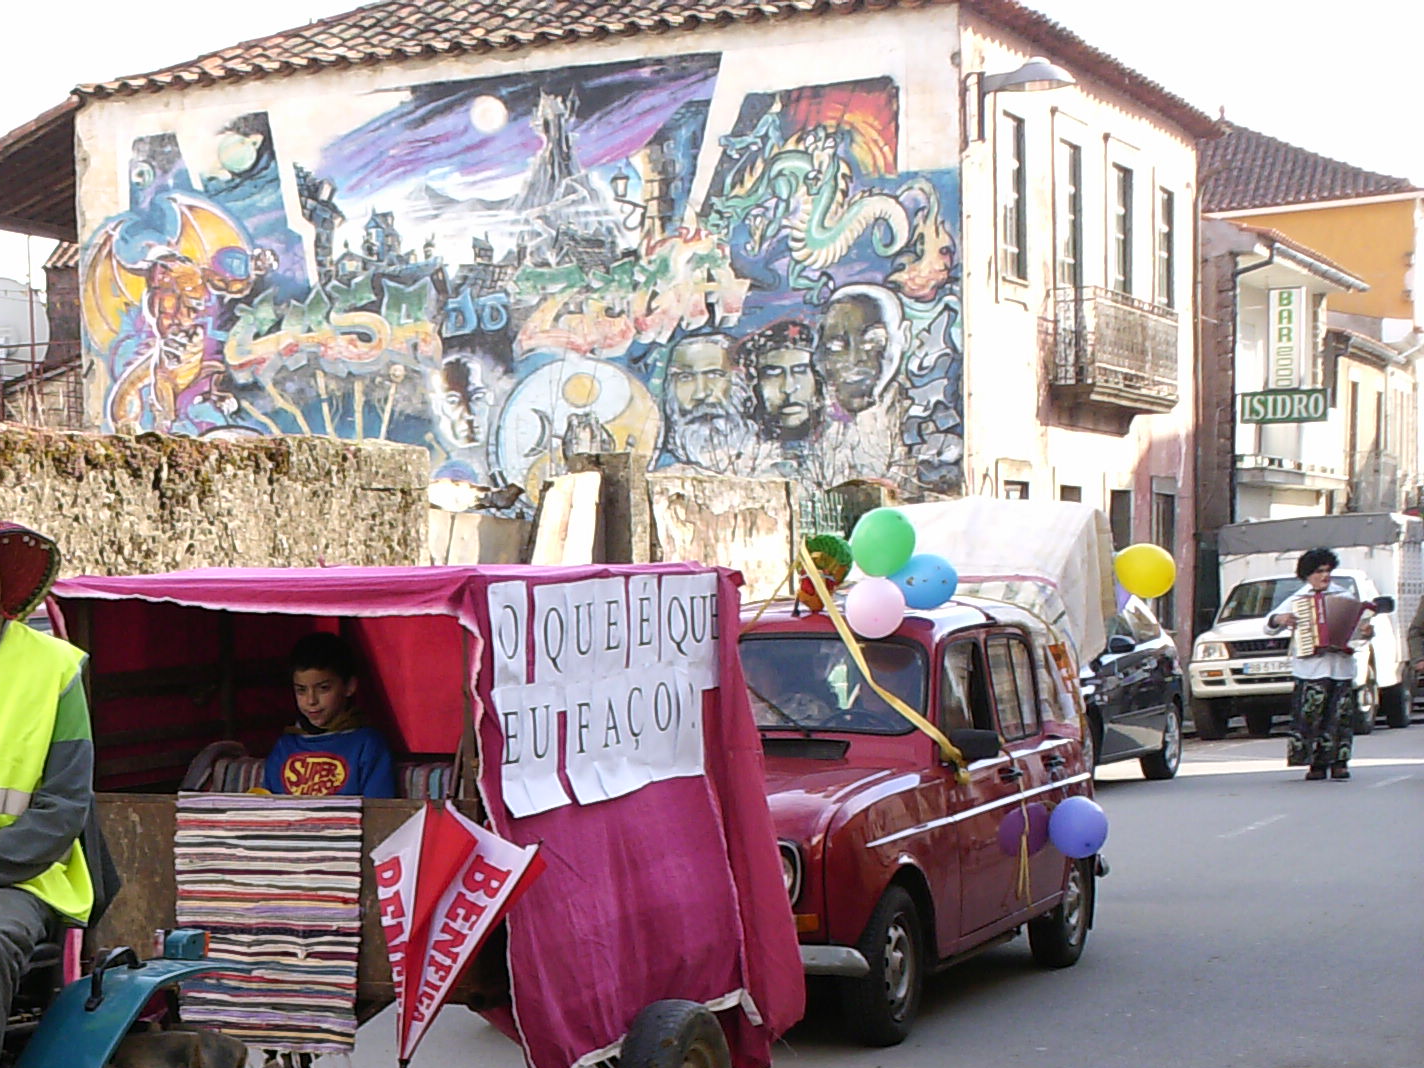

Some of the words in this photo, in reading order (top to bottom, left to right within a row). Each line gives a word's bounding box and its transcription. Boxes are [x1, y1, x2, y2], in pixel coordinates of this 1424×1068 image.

[1278, 290, 1293, 343] BAR
[1243, 392, 1324, 420] ISIDRO
[498, 604, 519, 660] O
[543, 600, 621, 673] QUE
[637, 582, 652, 646] É
[667, 593, 719, 656] QUE
[502, 704, 551, 765] EU
[412, 854, 512, 1022] BENFICA
